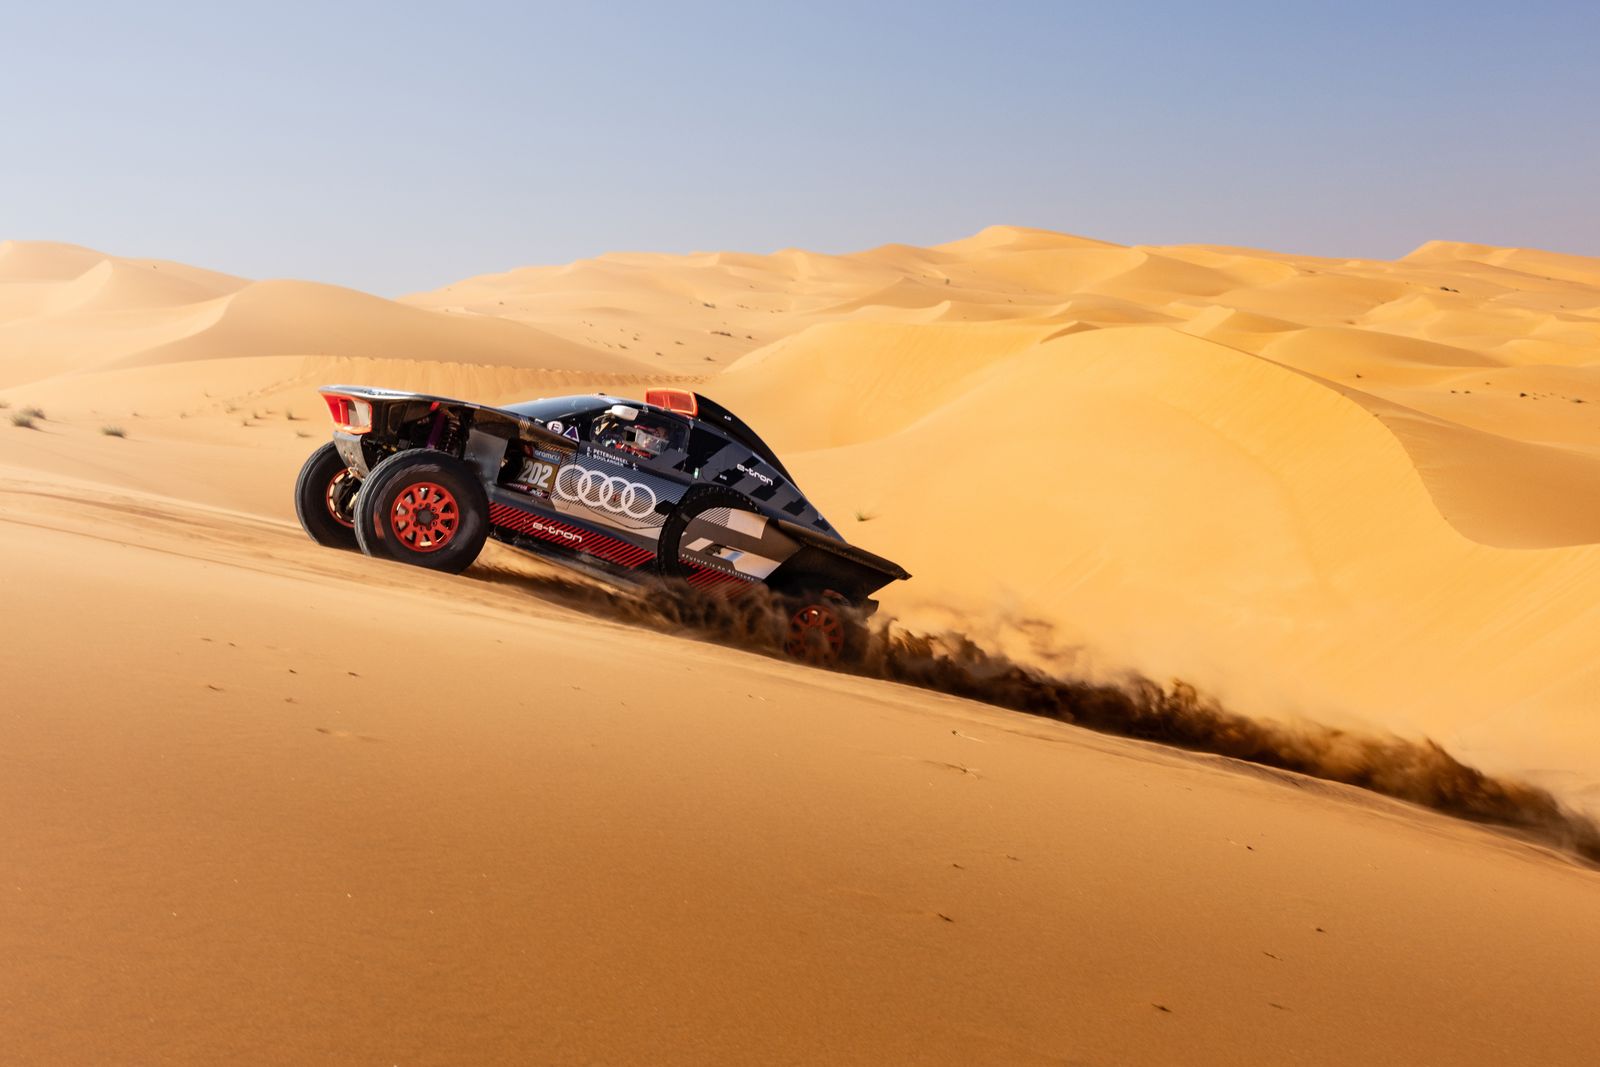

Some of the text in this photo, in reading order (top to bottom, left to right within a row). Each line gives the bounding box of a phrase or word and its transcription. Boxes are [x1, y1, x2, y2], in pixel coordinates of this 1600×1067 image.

[593, 448, 629, 465] PETERHANSEL
[519, 459, 553, 489] 202
[736, 463, 774, 486] e-tron
[532, 521, 583, 543] e-tron
